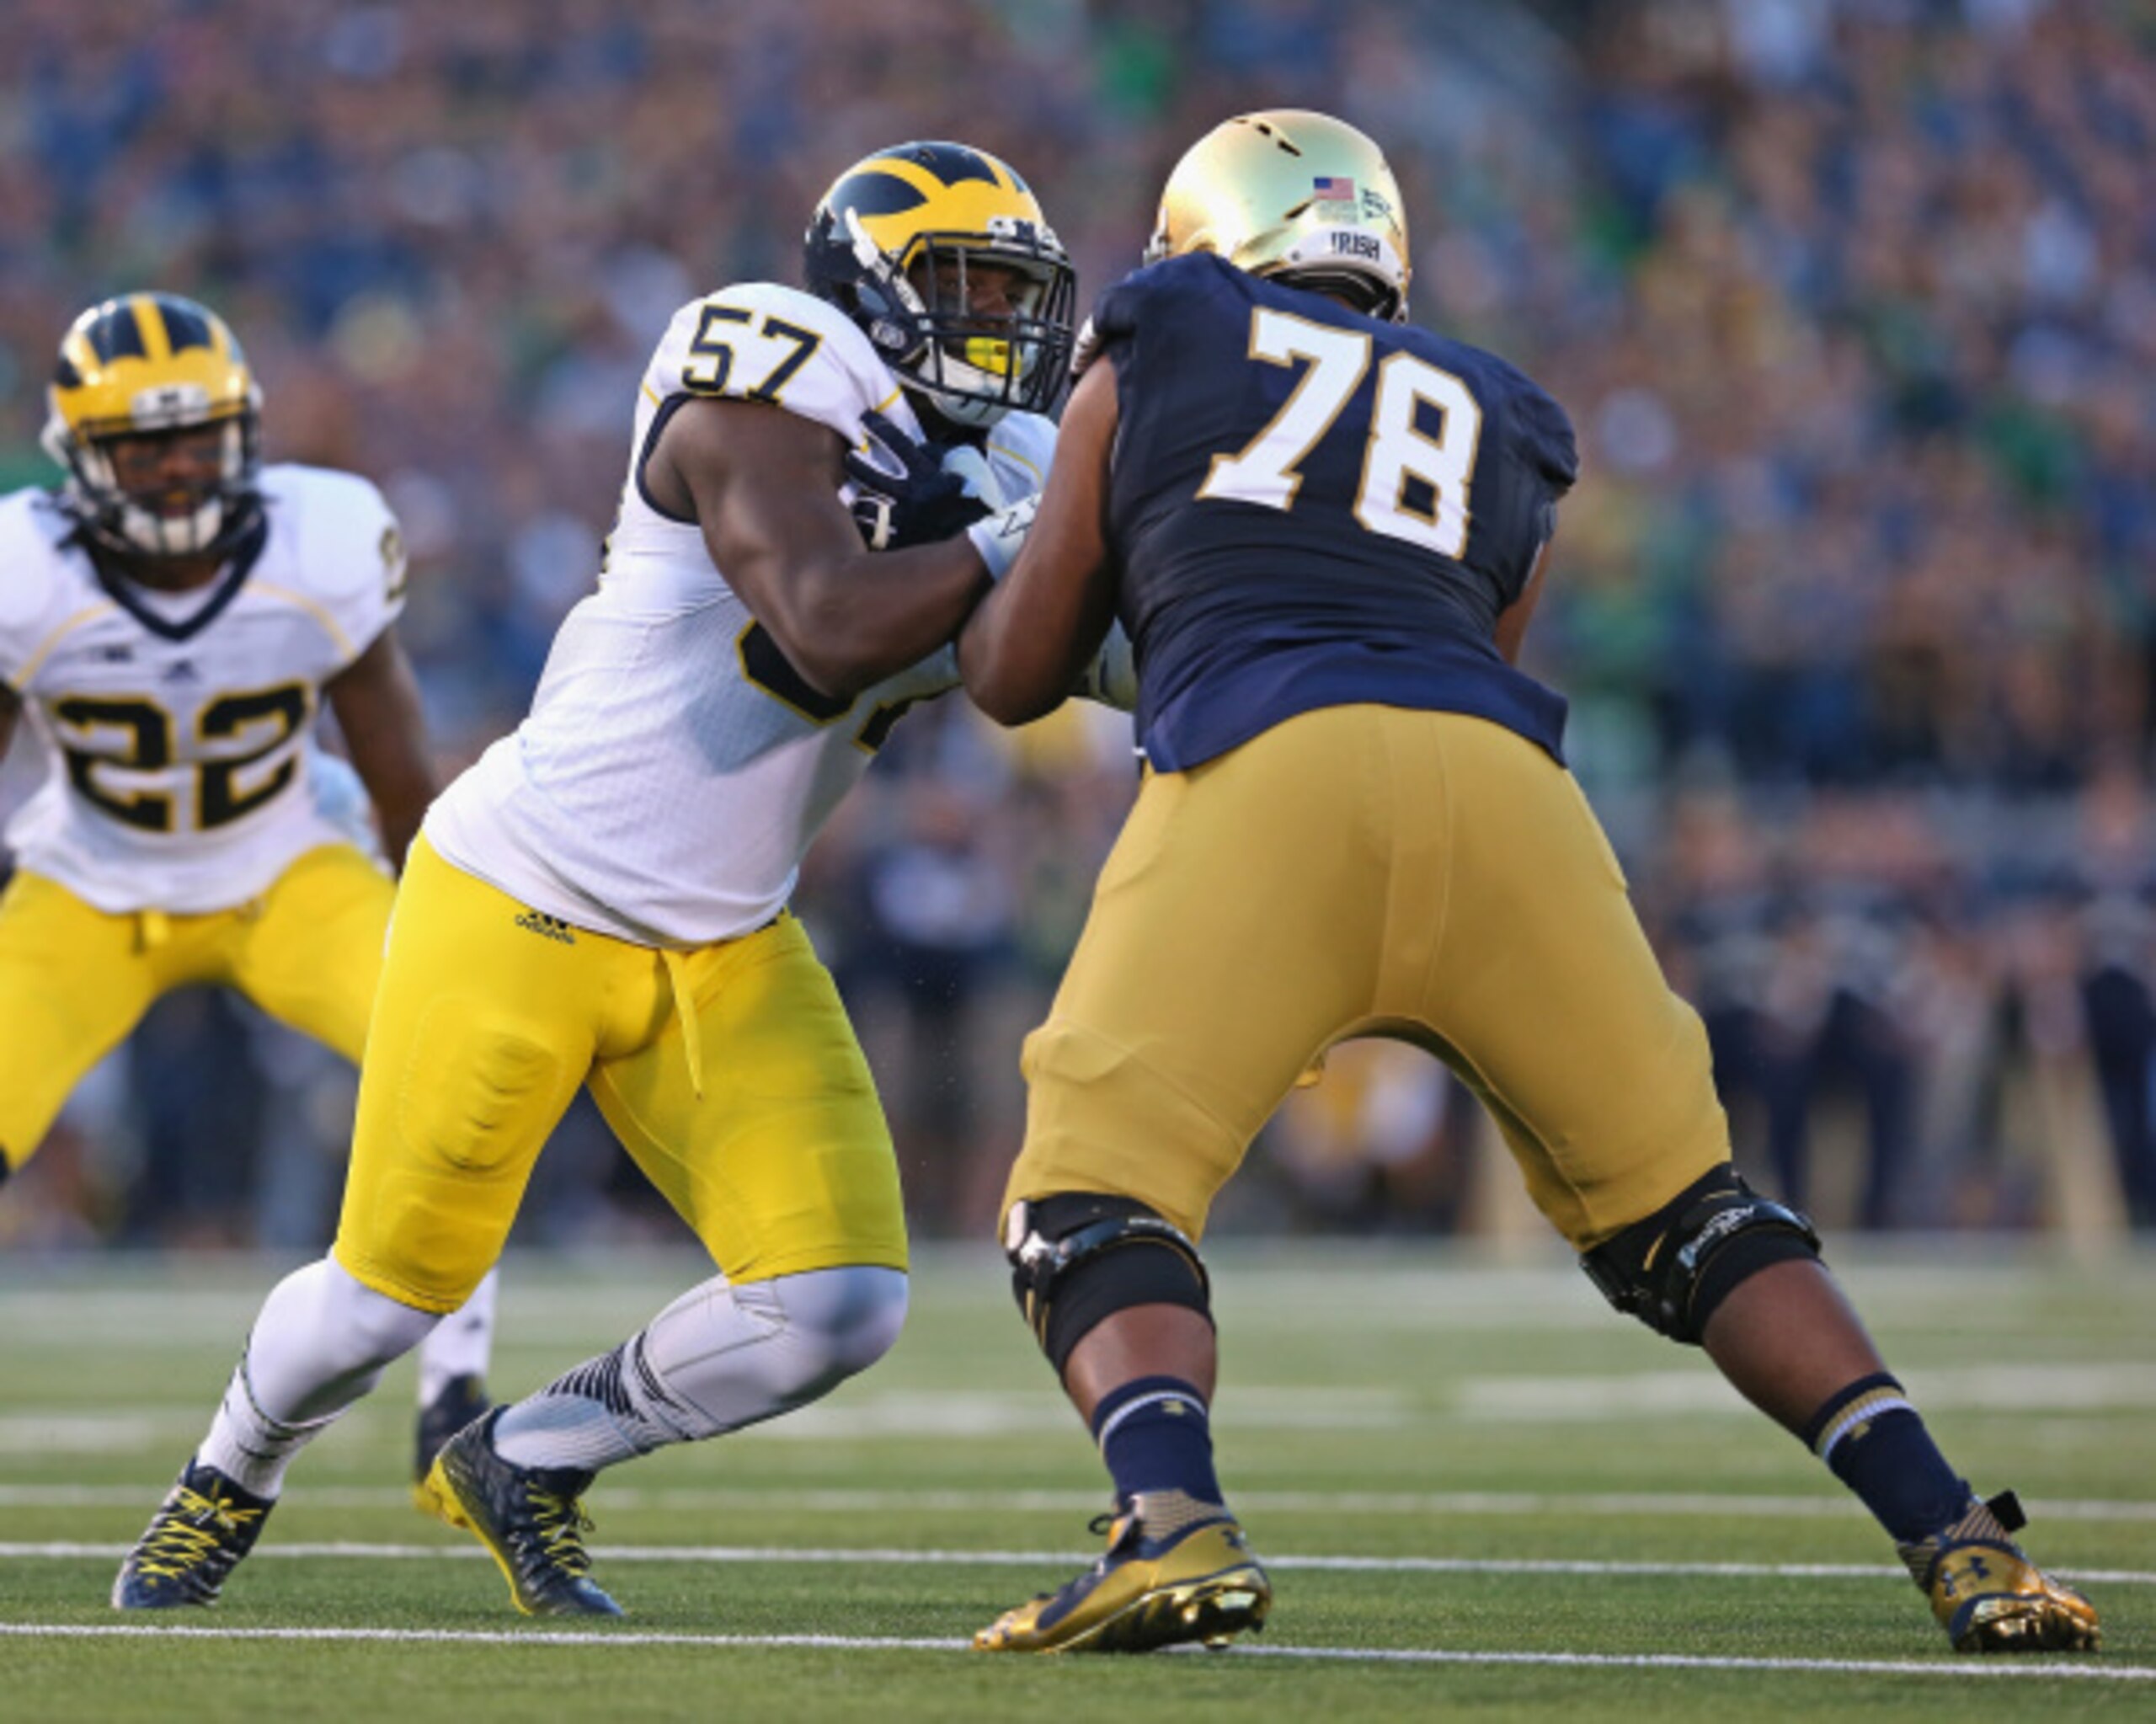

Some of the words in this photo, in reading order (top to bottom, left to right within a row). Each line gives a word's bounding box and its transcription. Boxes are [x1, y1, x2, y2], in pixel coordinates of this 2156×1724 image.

[1331, 231, 1380, 262] IRISH
[681, 304, 825, 407] 57
[1194, 305, 1482, 561] 78
[52, 679, 315, 834] 22
